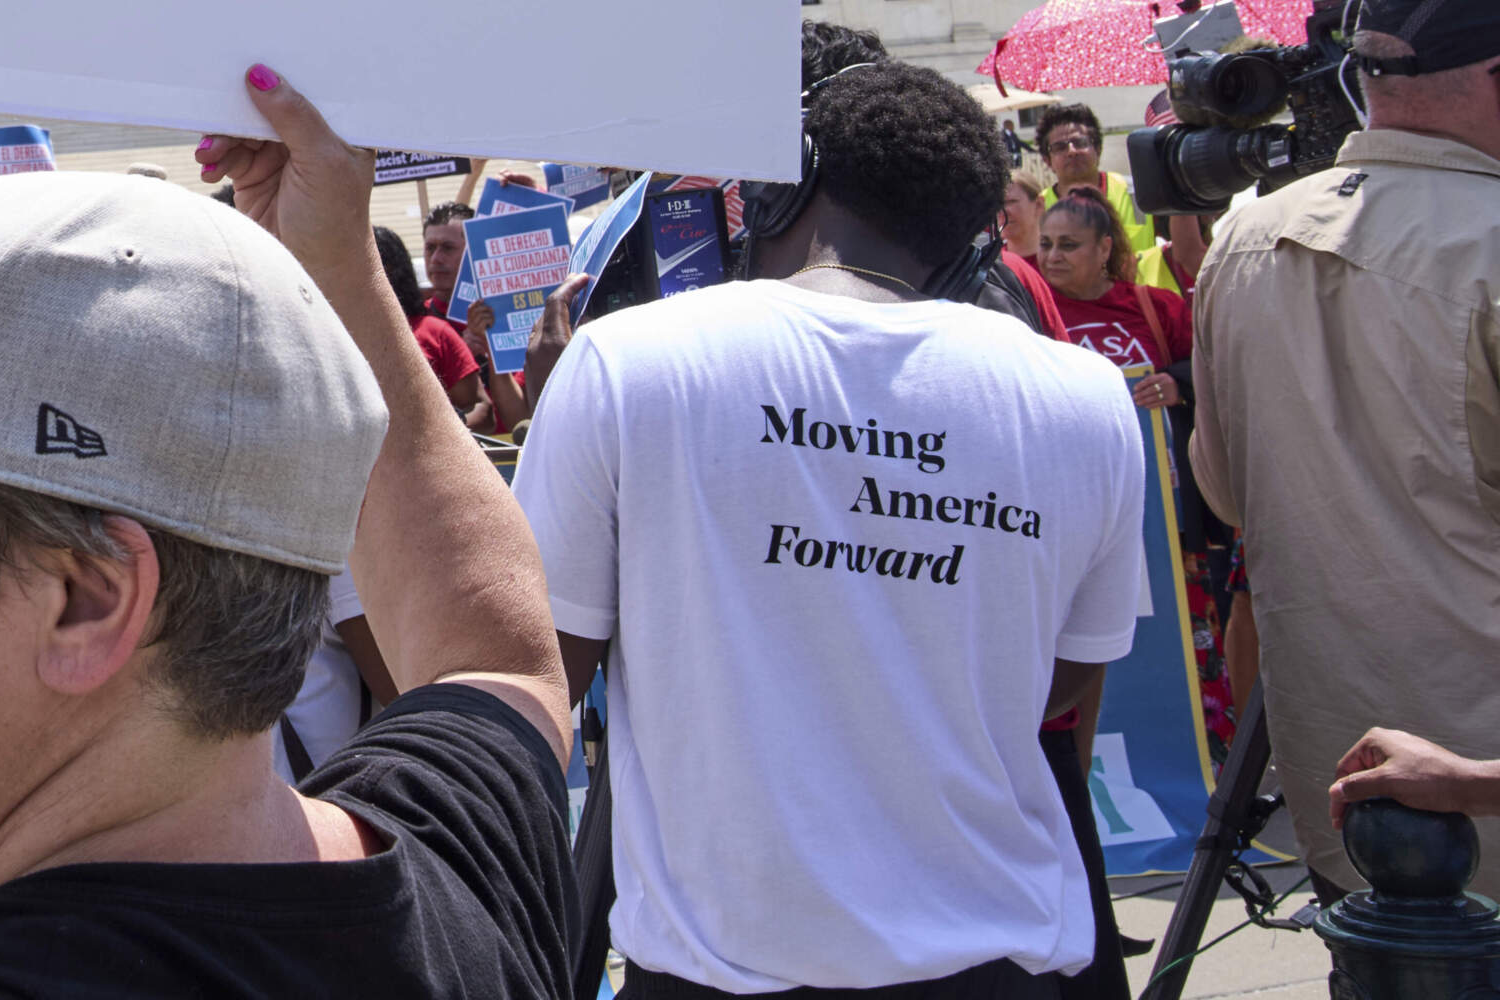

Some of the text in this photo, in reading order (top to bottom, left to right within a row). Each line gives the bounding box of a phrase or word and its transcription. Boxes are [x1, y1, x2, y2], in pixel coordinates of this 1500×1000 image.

[490, 231, 549, 255] EL DERECHO
[479, 262, 486, 277] A
[488, 259, 502, 275] LA
[482, 279, 503, 297] POR
[513, 290, 544, 309] ES UN
[1079, 334, 1153, 366] ASA
[760, 404, 946, 474] Moving
[849, 476, 1041, 540] America
[764, 524, 965, 586] Forward
